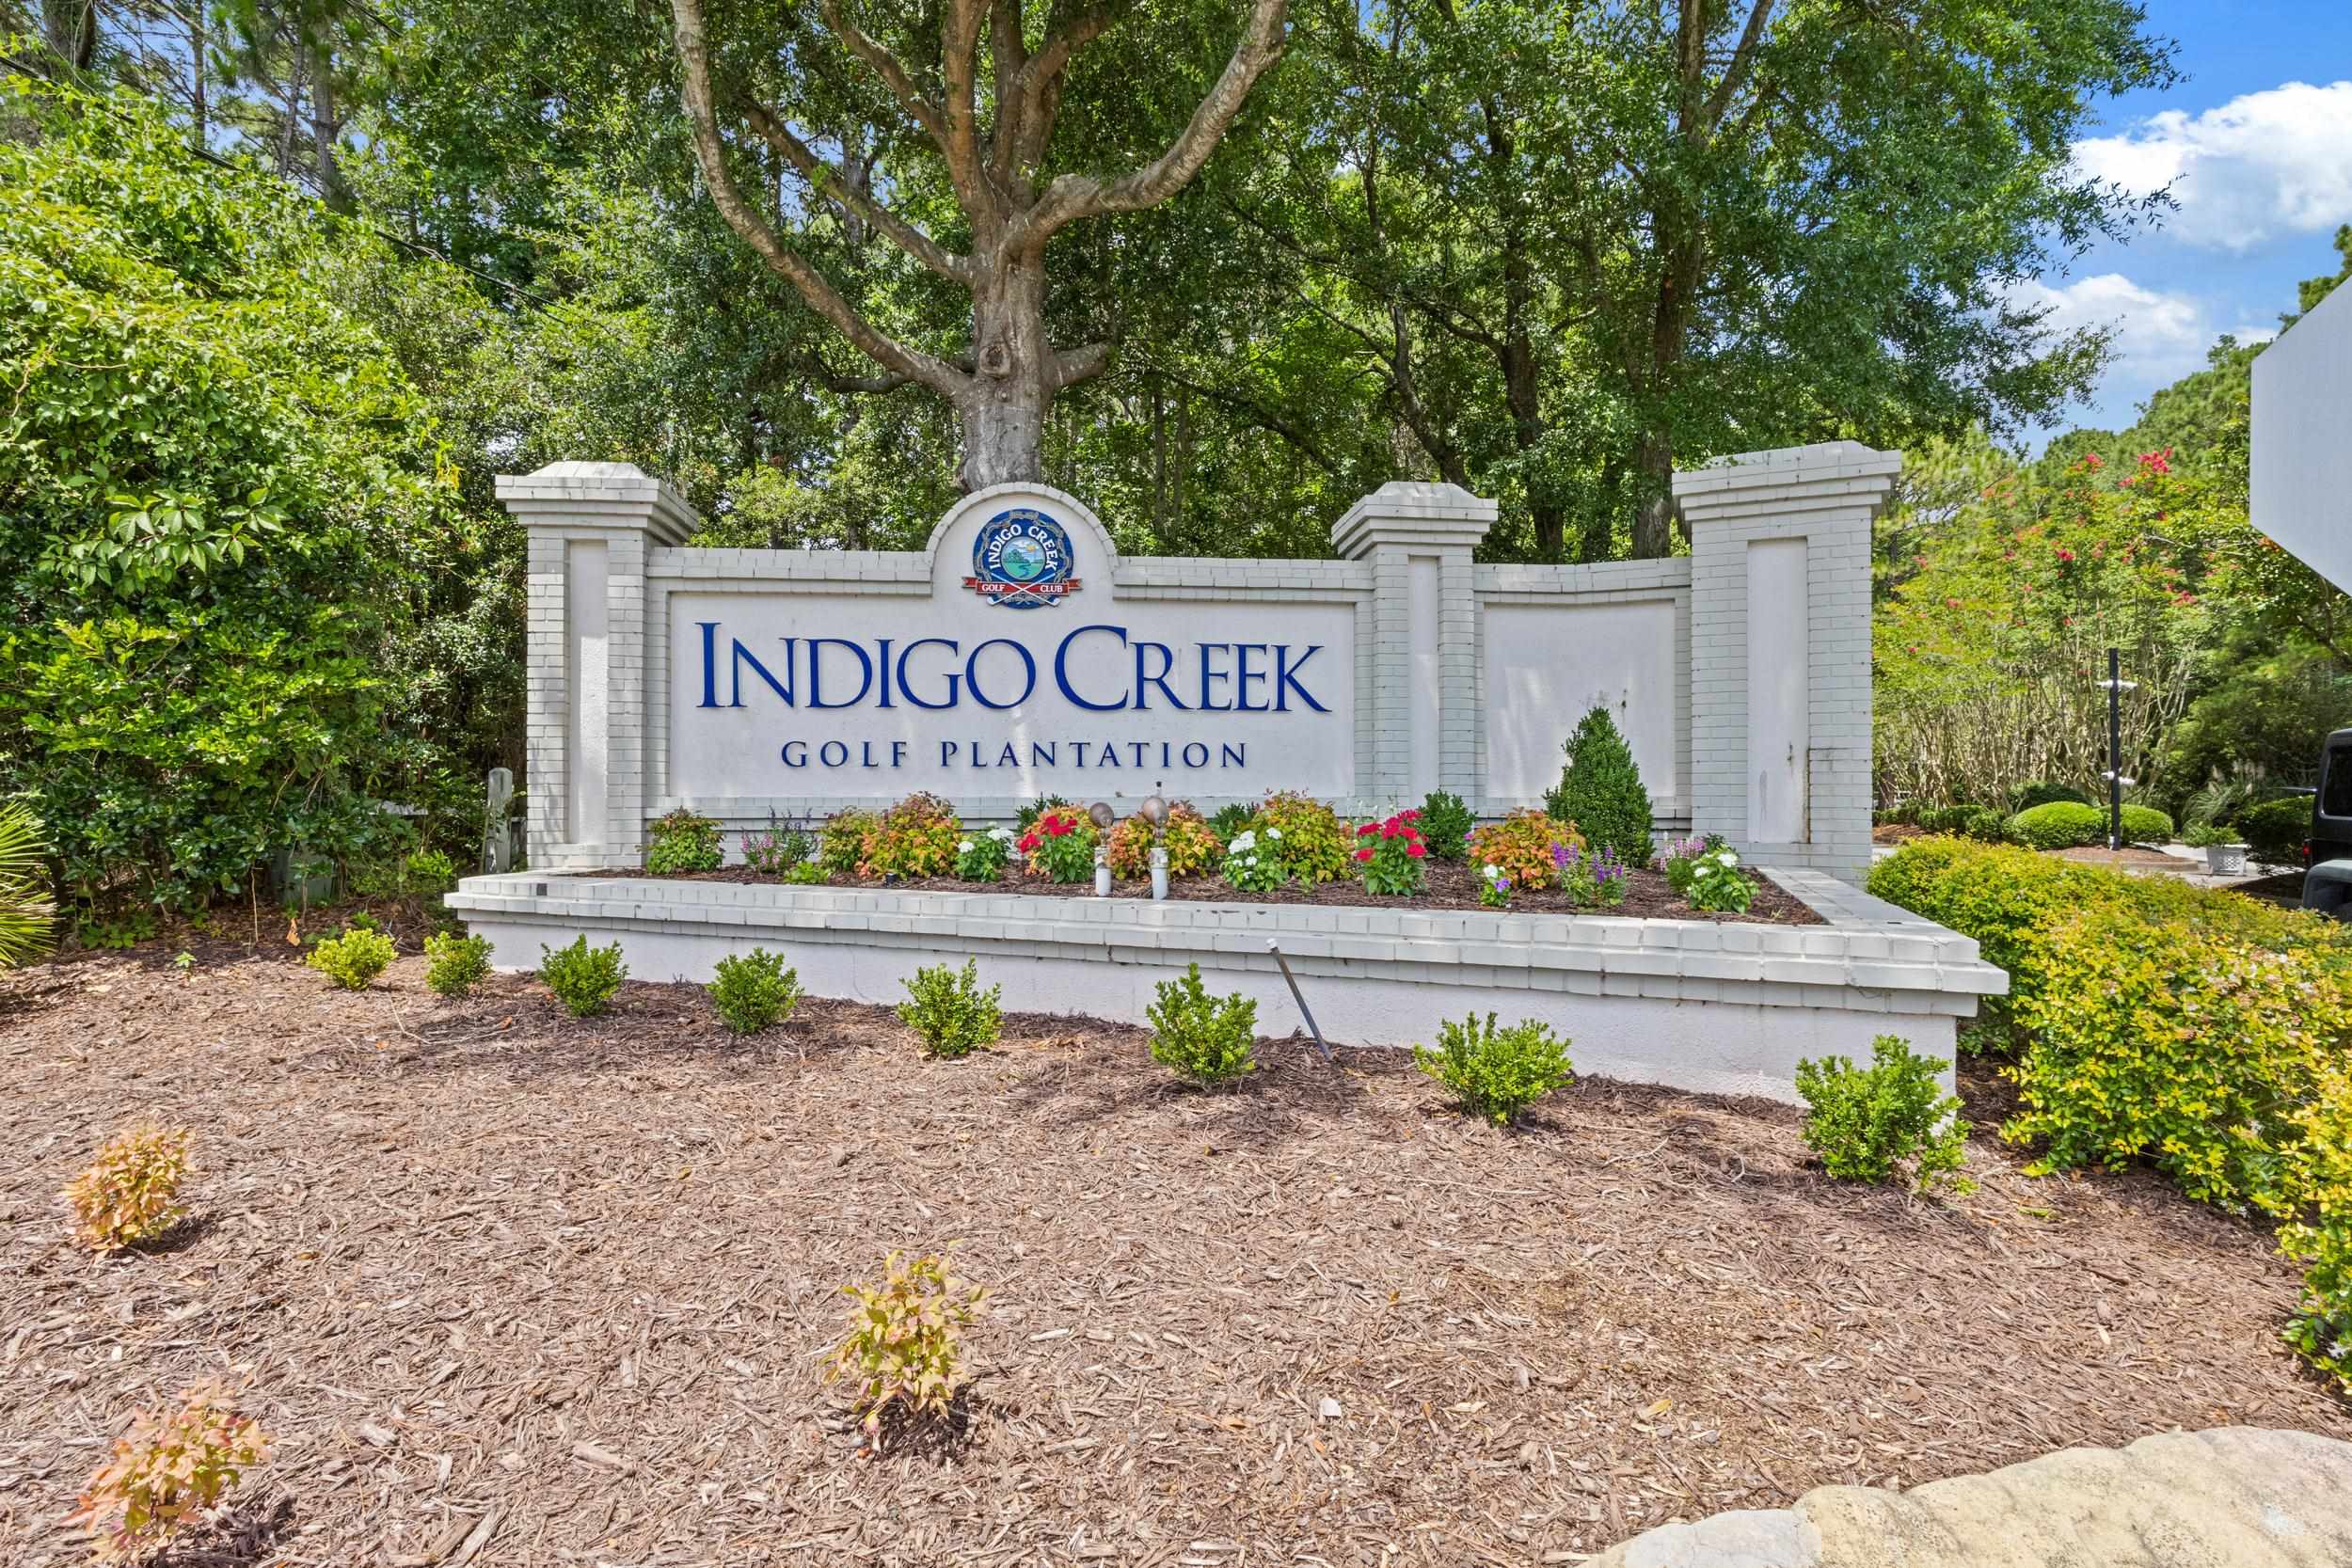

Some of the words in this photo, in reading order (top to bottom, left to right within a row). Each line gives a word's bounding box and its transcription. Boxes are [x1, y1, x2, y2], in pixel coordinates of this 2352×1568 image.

[988, 524, 1023, 570] INDIGO
[1027, 526, 1058, 572] CREEK
[981, 583, 1006, 592] GOLF
[1040, 584, 1063, 593] CLUB
[694, 622, 1037, 709] INDIGO
[1054, 625, 1333, 713] CREEK
[781, 740, 909, 768] GOLF
[941, 741, 1248, 768] PLANTATION
